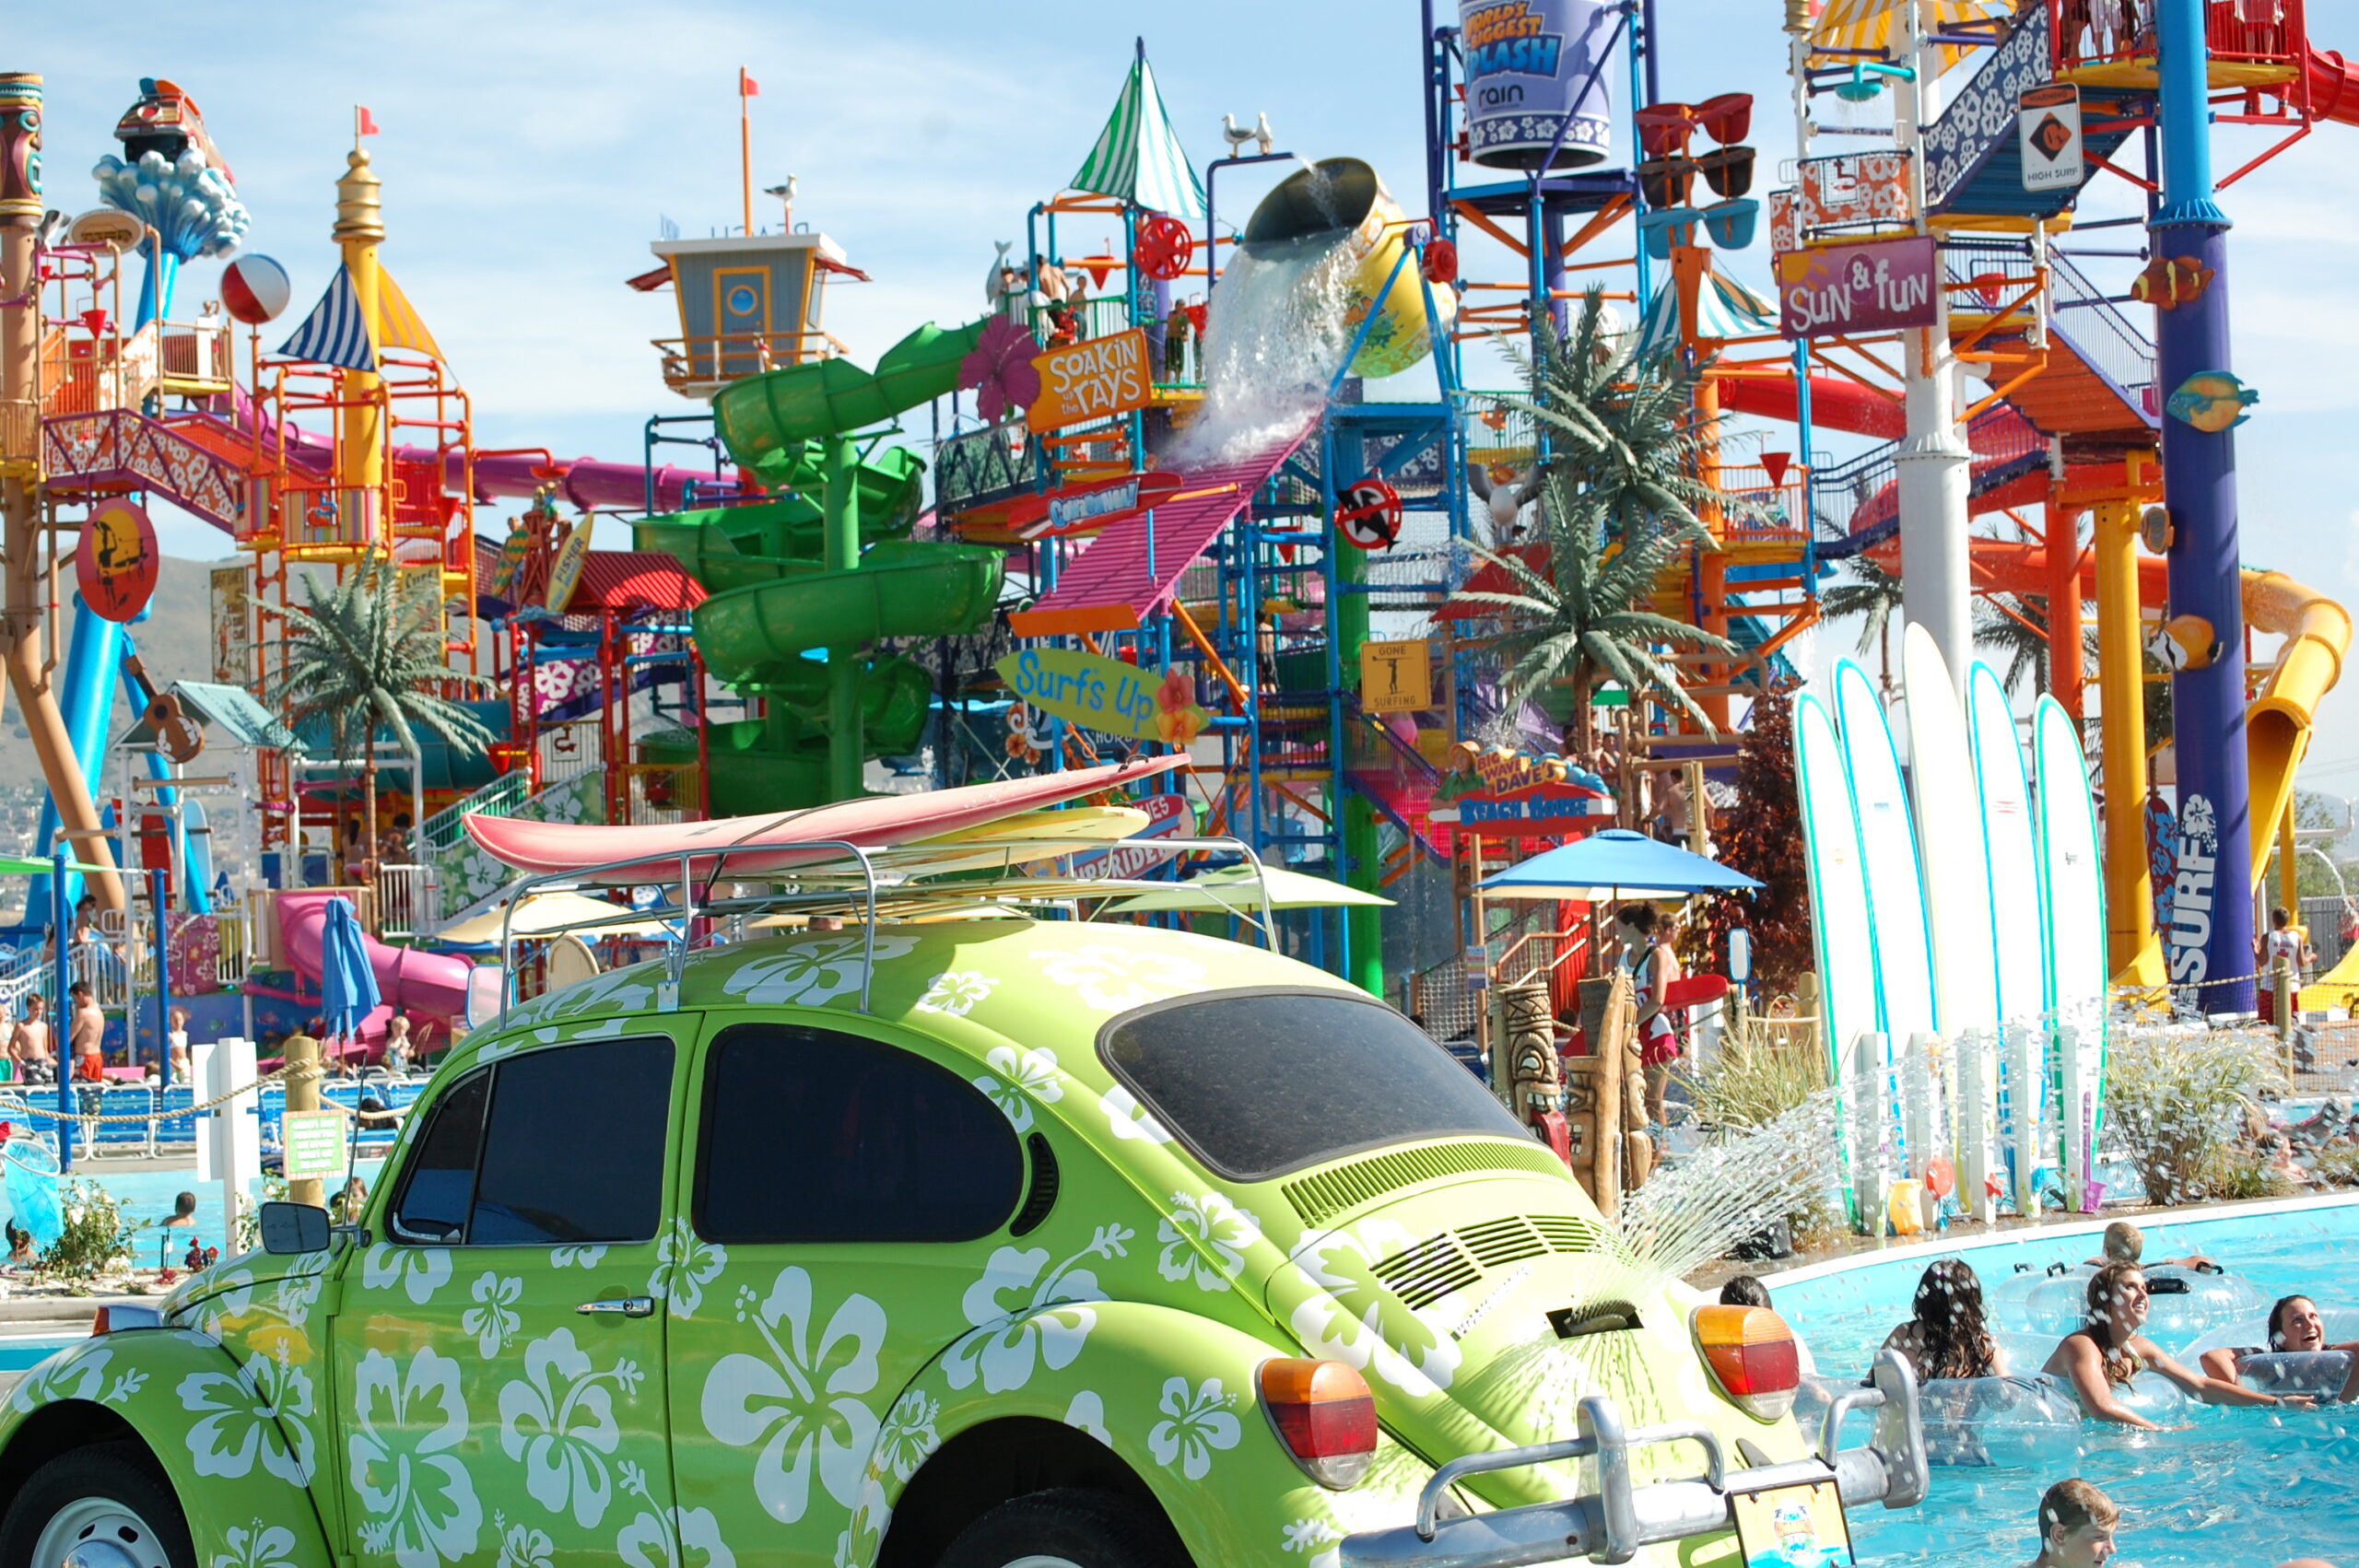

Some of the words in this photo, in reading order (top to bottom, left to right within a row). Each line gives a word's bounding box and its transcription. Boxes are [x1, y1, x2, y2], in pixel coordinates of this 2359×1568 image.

[1478, 84, 1524, 107] rain
[2027, 170, 2053, 181] HIGH
[2054, 166, 2079, 180] SURF
[1852, 261, 1872, 291] &
[1379, 645, 1407, 656] GONE
[1115, 676, 1155, 733] Up
[1373, 695, 1416, 708] SURFING
[1477, 753, 1501, 771] BIG
[1485, 759, 1521, 782] WAVE
[1495, 761, 1555, 794] DAVE'S
[2170, 836, 2216, 983] SURF
